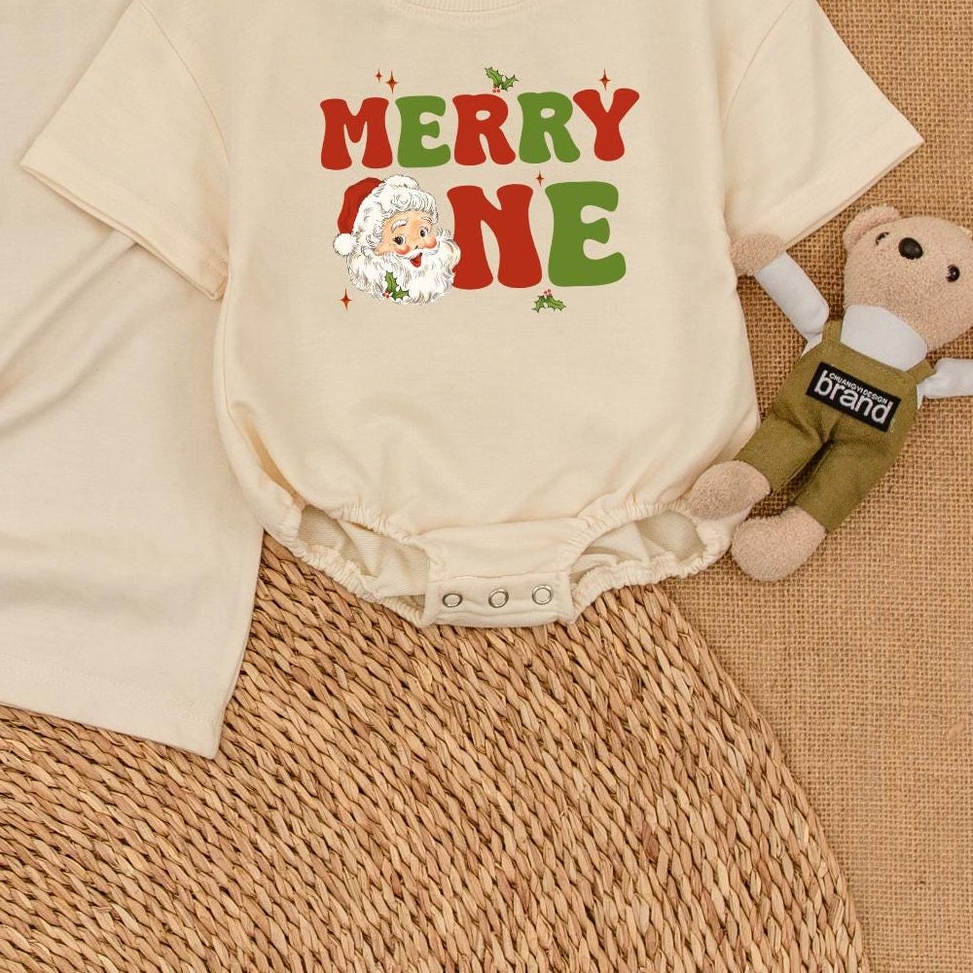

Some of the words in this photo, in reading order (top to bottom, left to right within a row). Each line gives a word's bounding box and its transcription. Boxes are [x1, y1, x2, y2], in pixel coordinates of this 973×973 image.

[320, 88, 640, 170] MERRY
[333, 177, 626, 293] NE
[814, 369, 893, 424] brand
